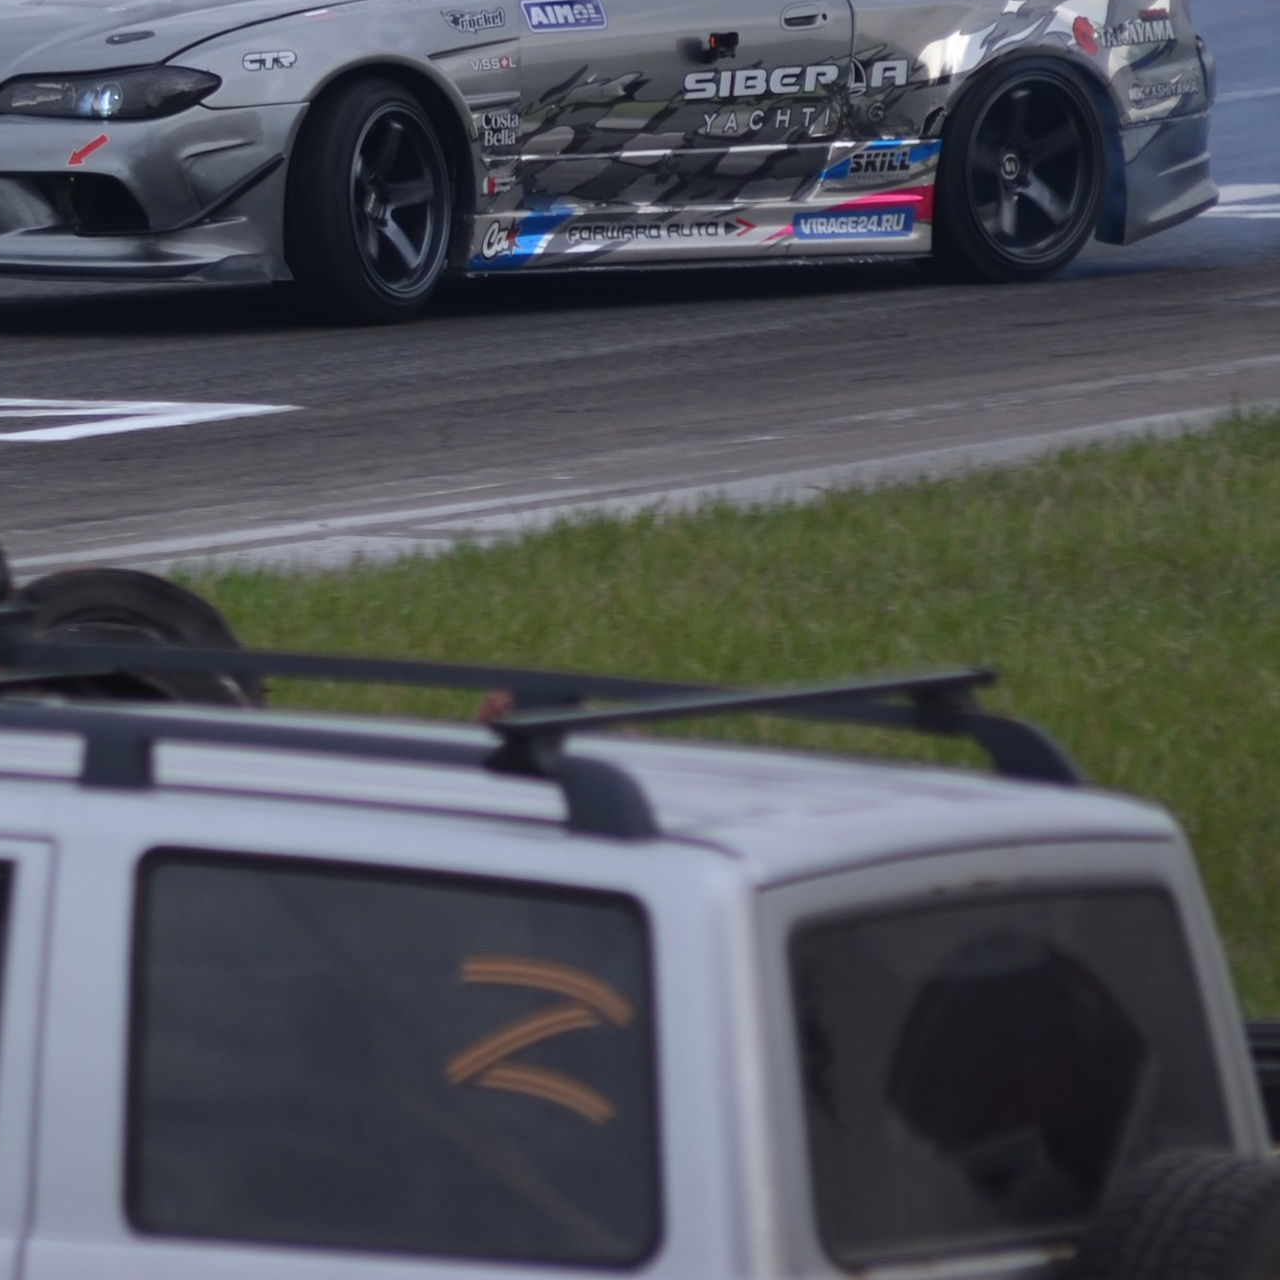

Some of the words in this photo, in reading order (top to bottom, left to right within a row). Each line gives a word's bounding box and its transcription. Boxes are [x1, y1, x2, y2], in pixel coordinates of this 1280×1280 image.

[530, 3, 602, 26] AIMOL
[243, 49, 297, 72] CTR
[482, 113, 519, 130] Costa
[484, 129, 516, 147] Bella
[850, 150, 910, 173] SKILL
[568, 224, 661, 242] FORWARD
[667, 221, 719, 238] AUTO
[800, 213, 906, 235] VIRAGE24.RU
